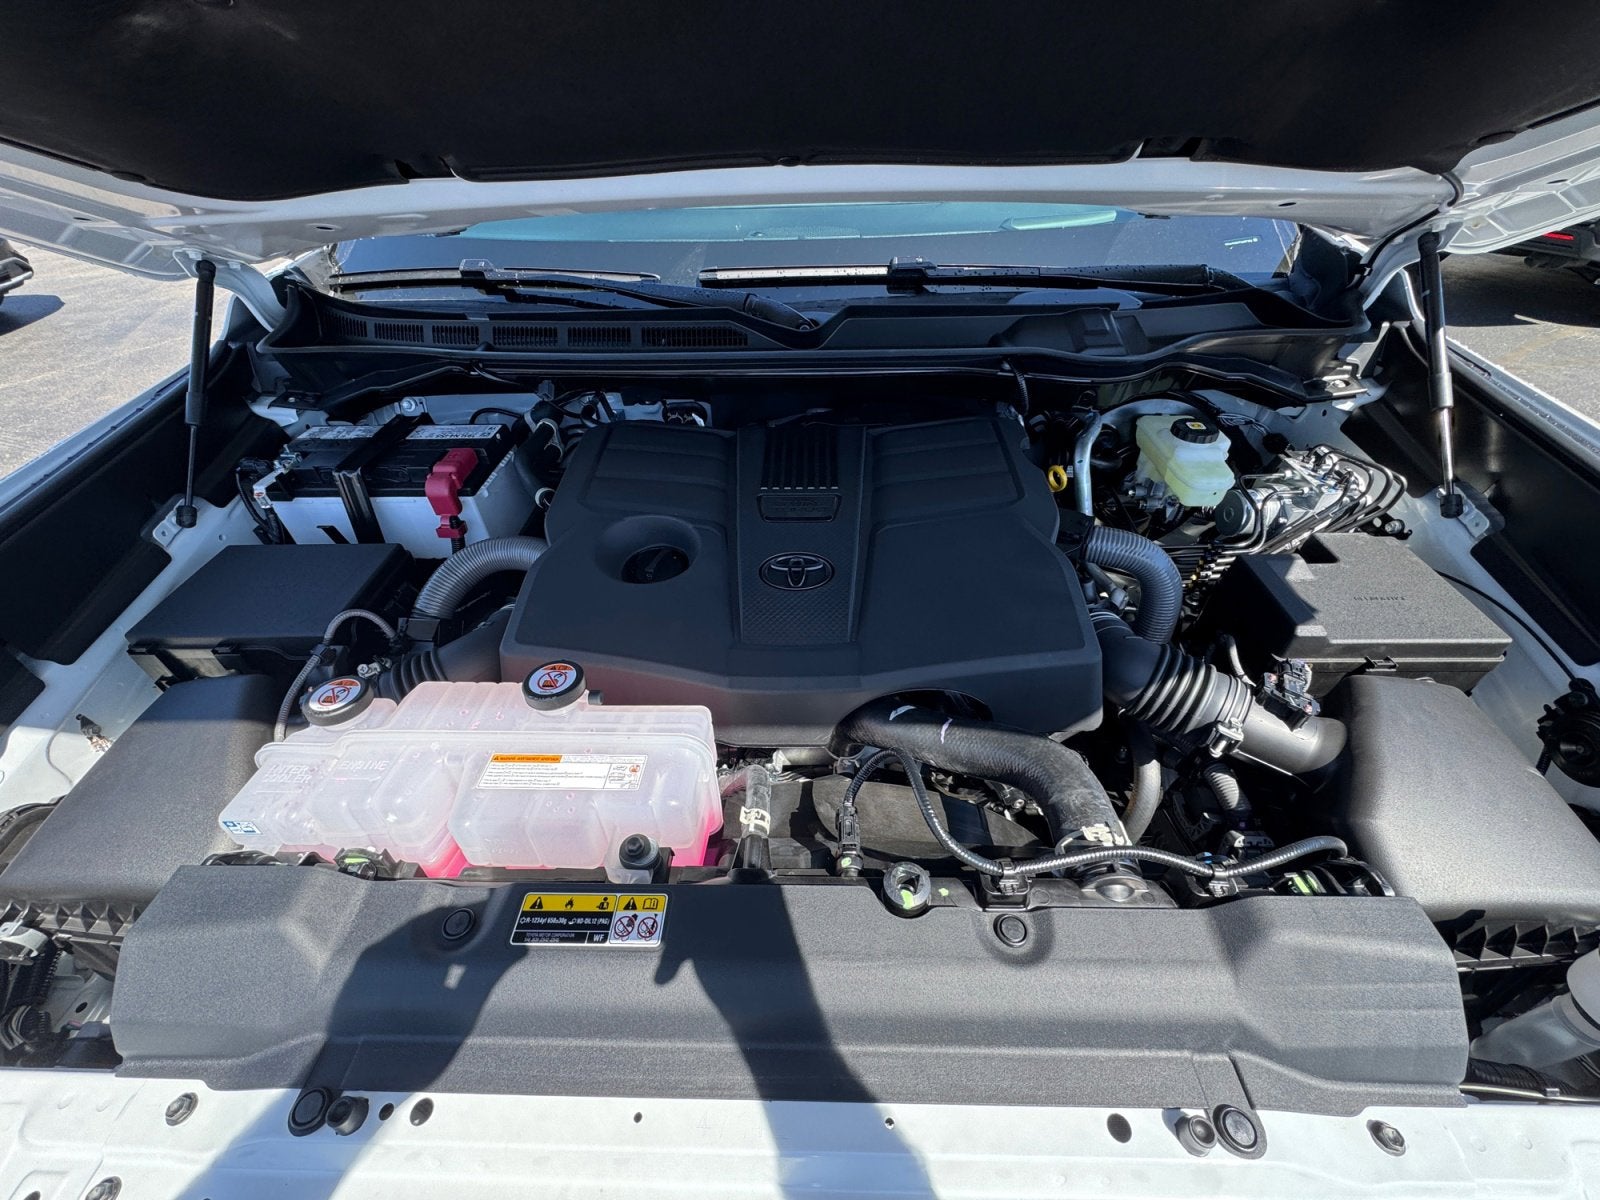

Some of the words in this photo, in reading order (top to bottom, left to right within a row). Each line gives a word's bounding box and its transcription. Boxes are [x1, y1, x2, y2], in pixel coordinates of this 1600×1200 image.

[338, 760, 389, 770] ENGINE
[525, 917, 547, 925] R-1234yf
[593, 934, 605, 942] WF
